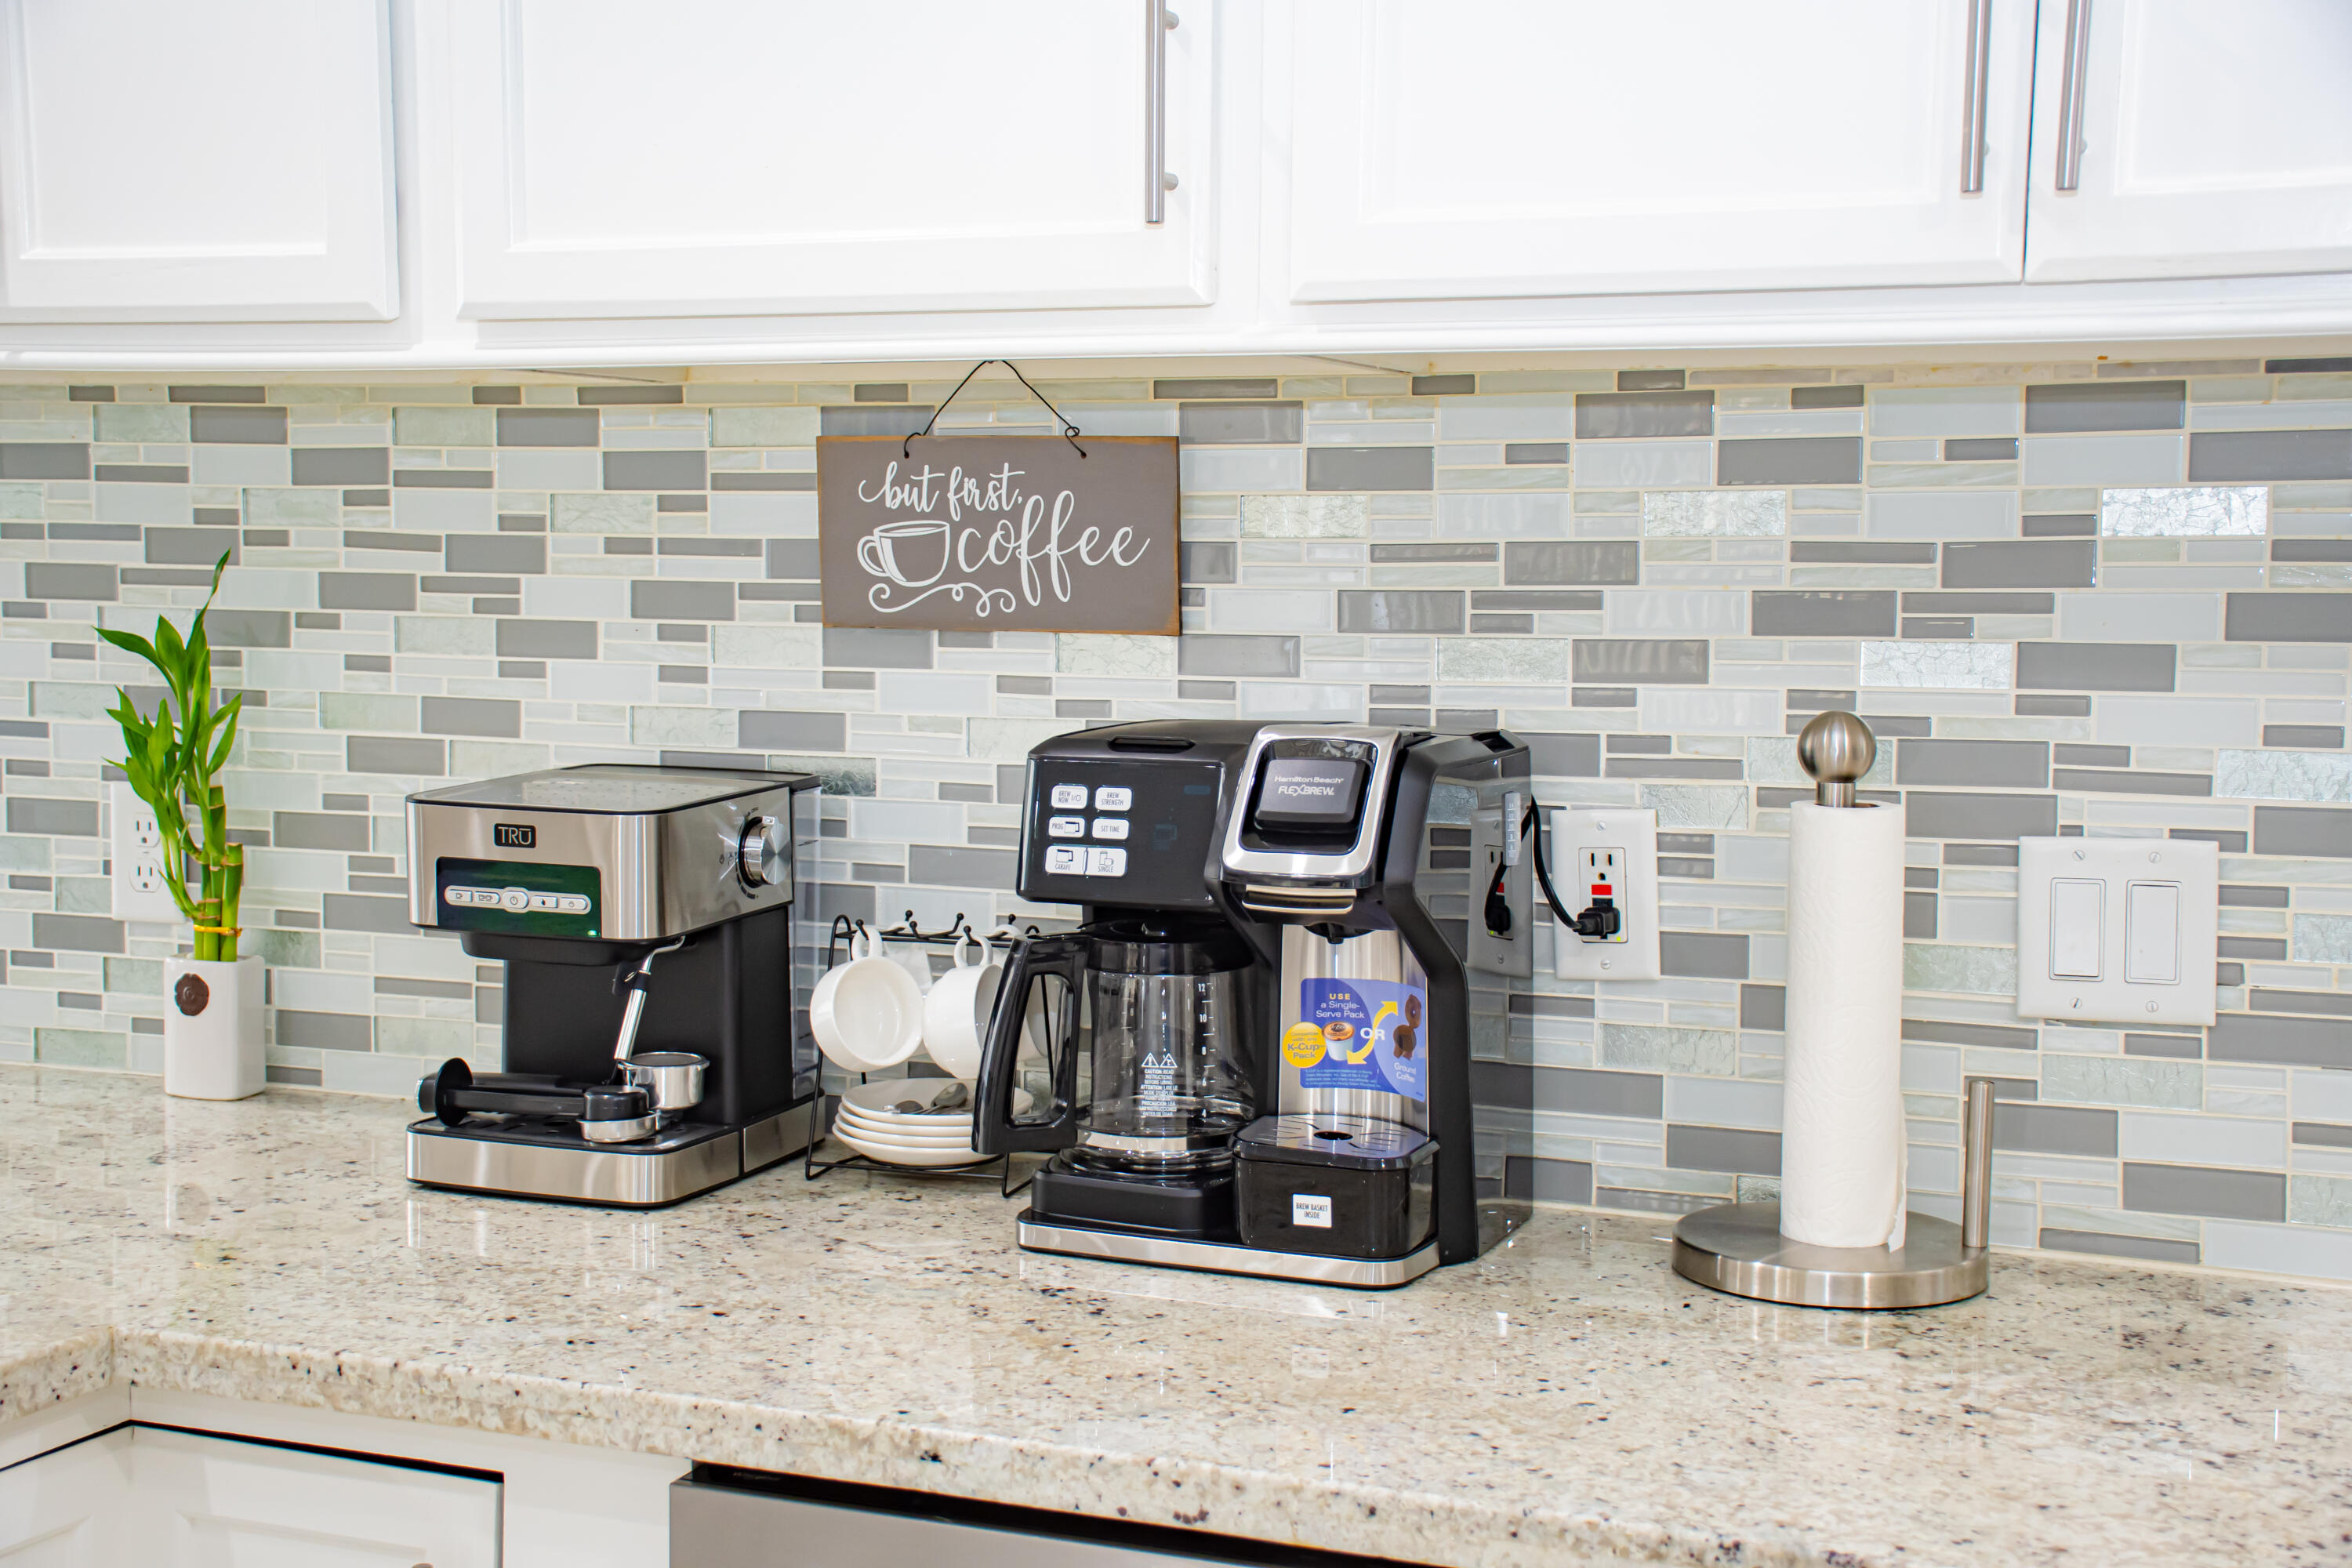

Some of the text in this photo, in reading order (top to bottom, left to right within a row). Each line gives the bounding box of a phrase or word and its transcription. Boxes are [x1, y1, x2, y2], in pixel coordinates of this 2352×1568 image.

[858, 461, 1025, 521] but first,
[957, 490, 1150, 607] coffee
[1197, 983, 1206, 992] 12
[1329, 1001, 1360, 1010] Single-
[1199, 1014, 1207, 1022] 10
[1344, 1010, 1365, 1018] Pack
[1360, 1027, 1385, 1041] OR
[1394, 1062, 1417, 1075] Ground
[1311, 1203, 1328, 1212] BASKET
[1304, 1210, 1320, 1219] INSIDE
